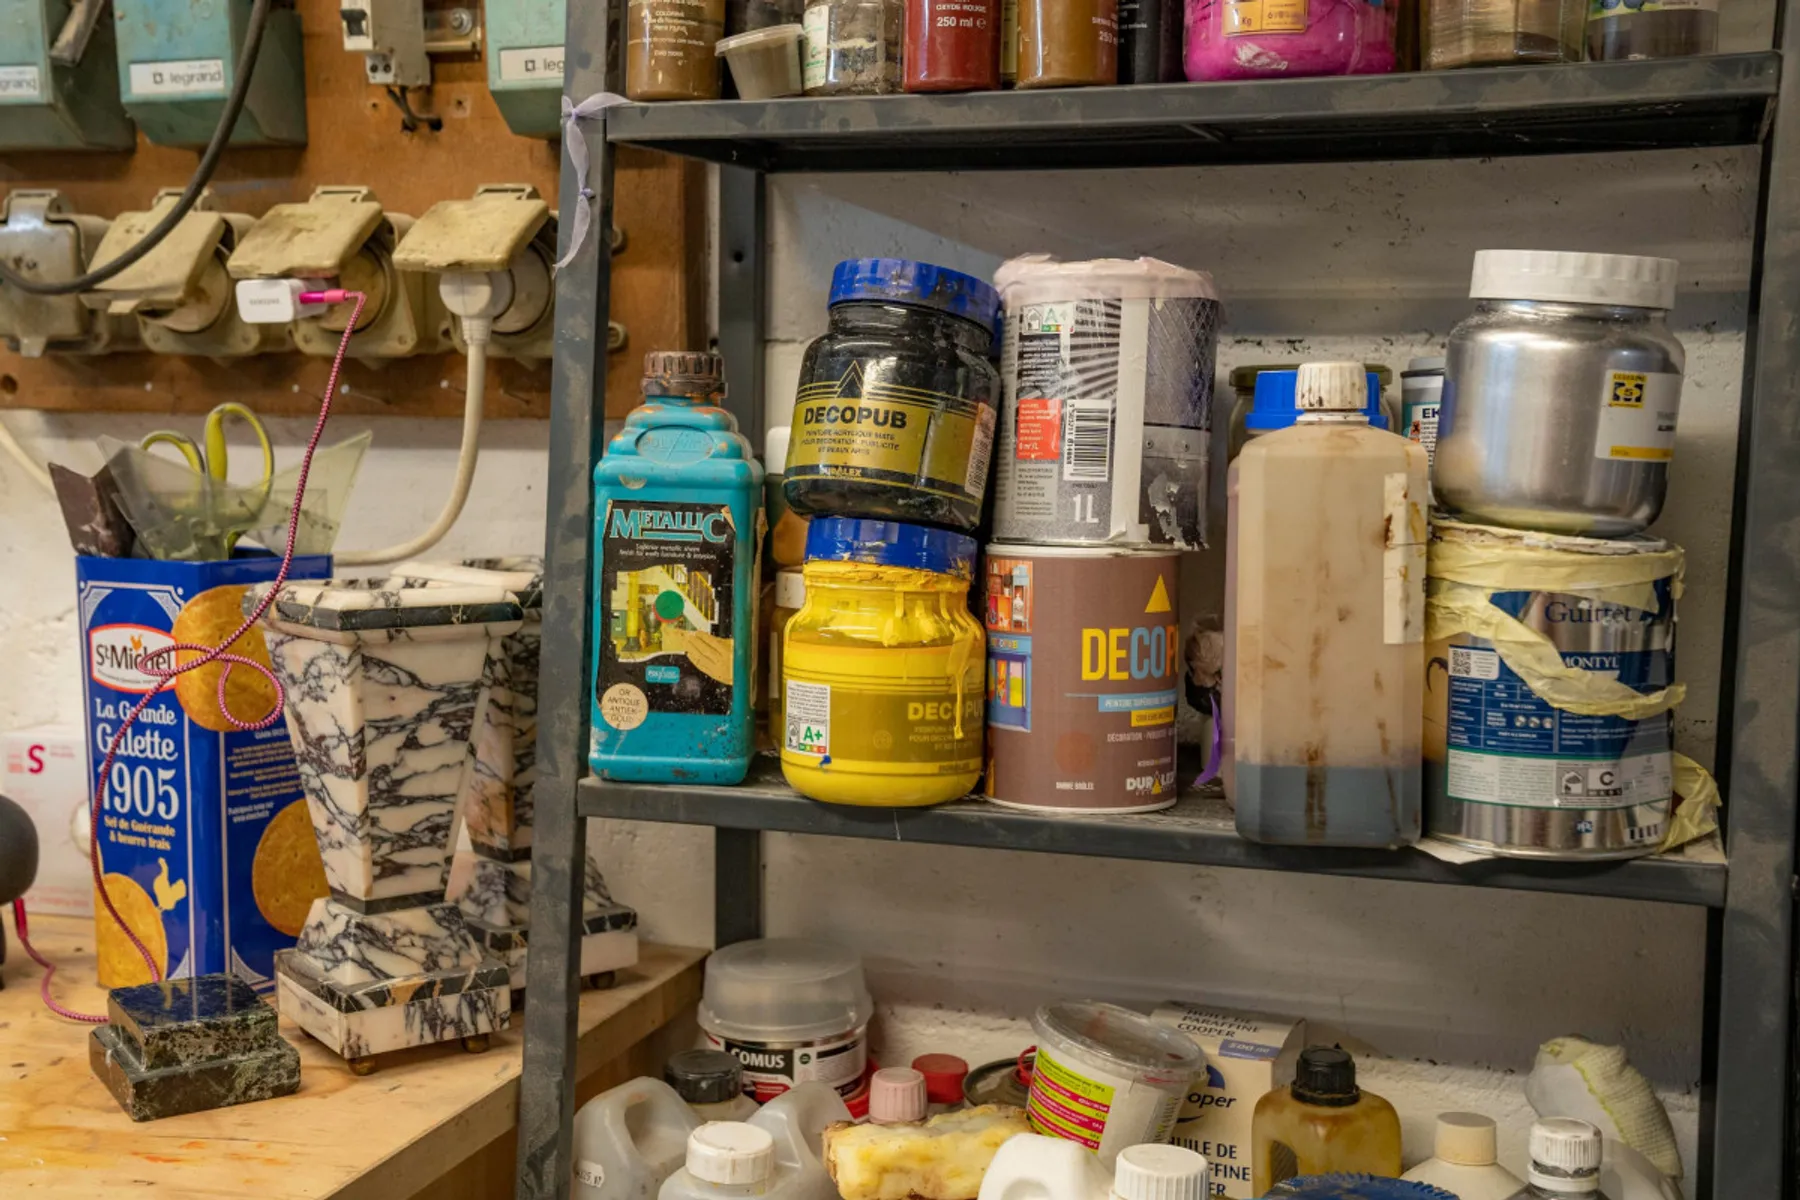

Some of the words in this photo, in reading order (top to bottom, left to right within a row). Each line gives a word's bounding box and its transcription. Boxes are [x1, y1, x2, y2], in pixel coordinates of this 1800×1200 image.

[936, 16, 957, 27] 250
[960, 17, 973, 27] ml
[169, 69, 222, 86] legrand
[804, 405, 907, 429] DECOPUB
[1073, 494, 1099, 523] 1L
[609, 508, 727, 542] METALLIC
[607, 696, 641, 706] ANTIQUE
[95, 699, 117, 719] La
[119, 701, 178, 725] Gande
[803, 726, 823, 743] A+
[28, 744, 45, 774] S
[1600, 771, 1614, 786] C
[97, 762, 180, 820] 1905
[118, 817, 130, 830] de
[1177, 1023, 1236, 1038] COOPER
[1182, 1015, 1258, 1033] PARAFFINE
[1228, 1042, 1254, 1052] 500
[1217, 1143, 1237, 1159] DE
